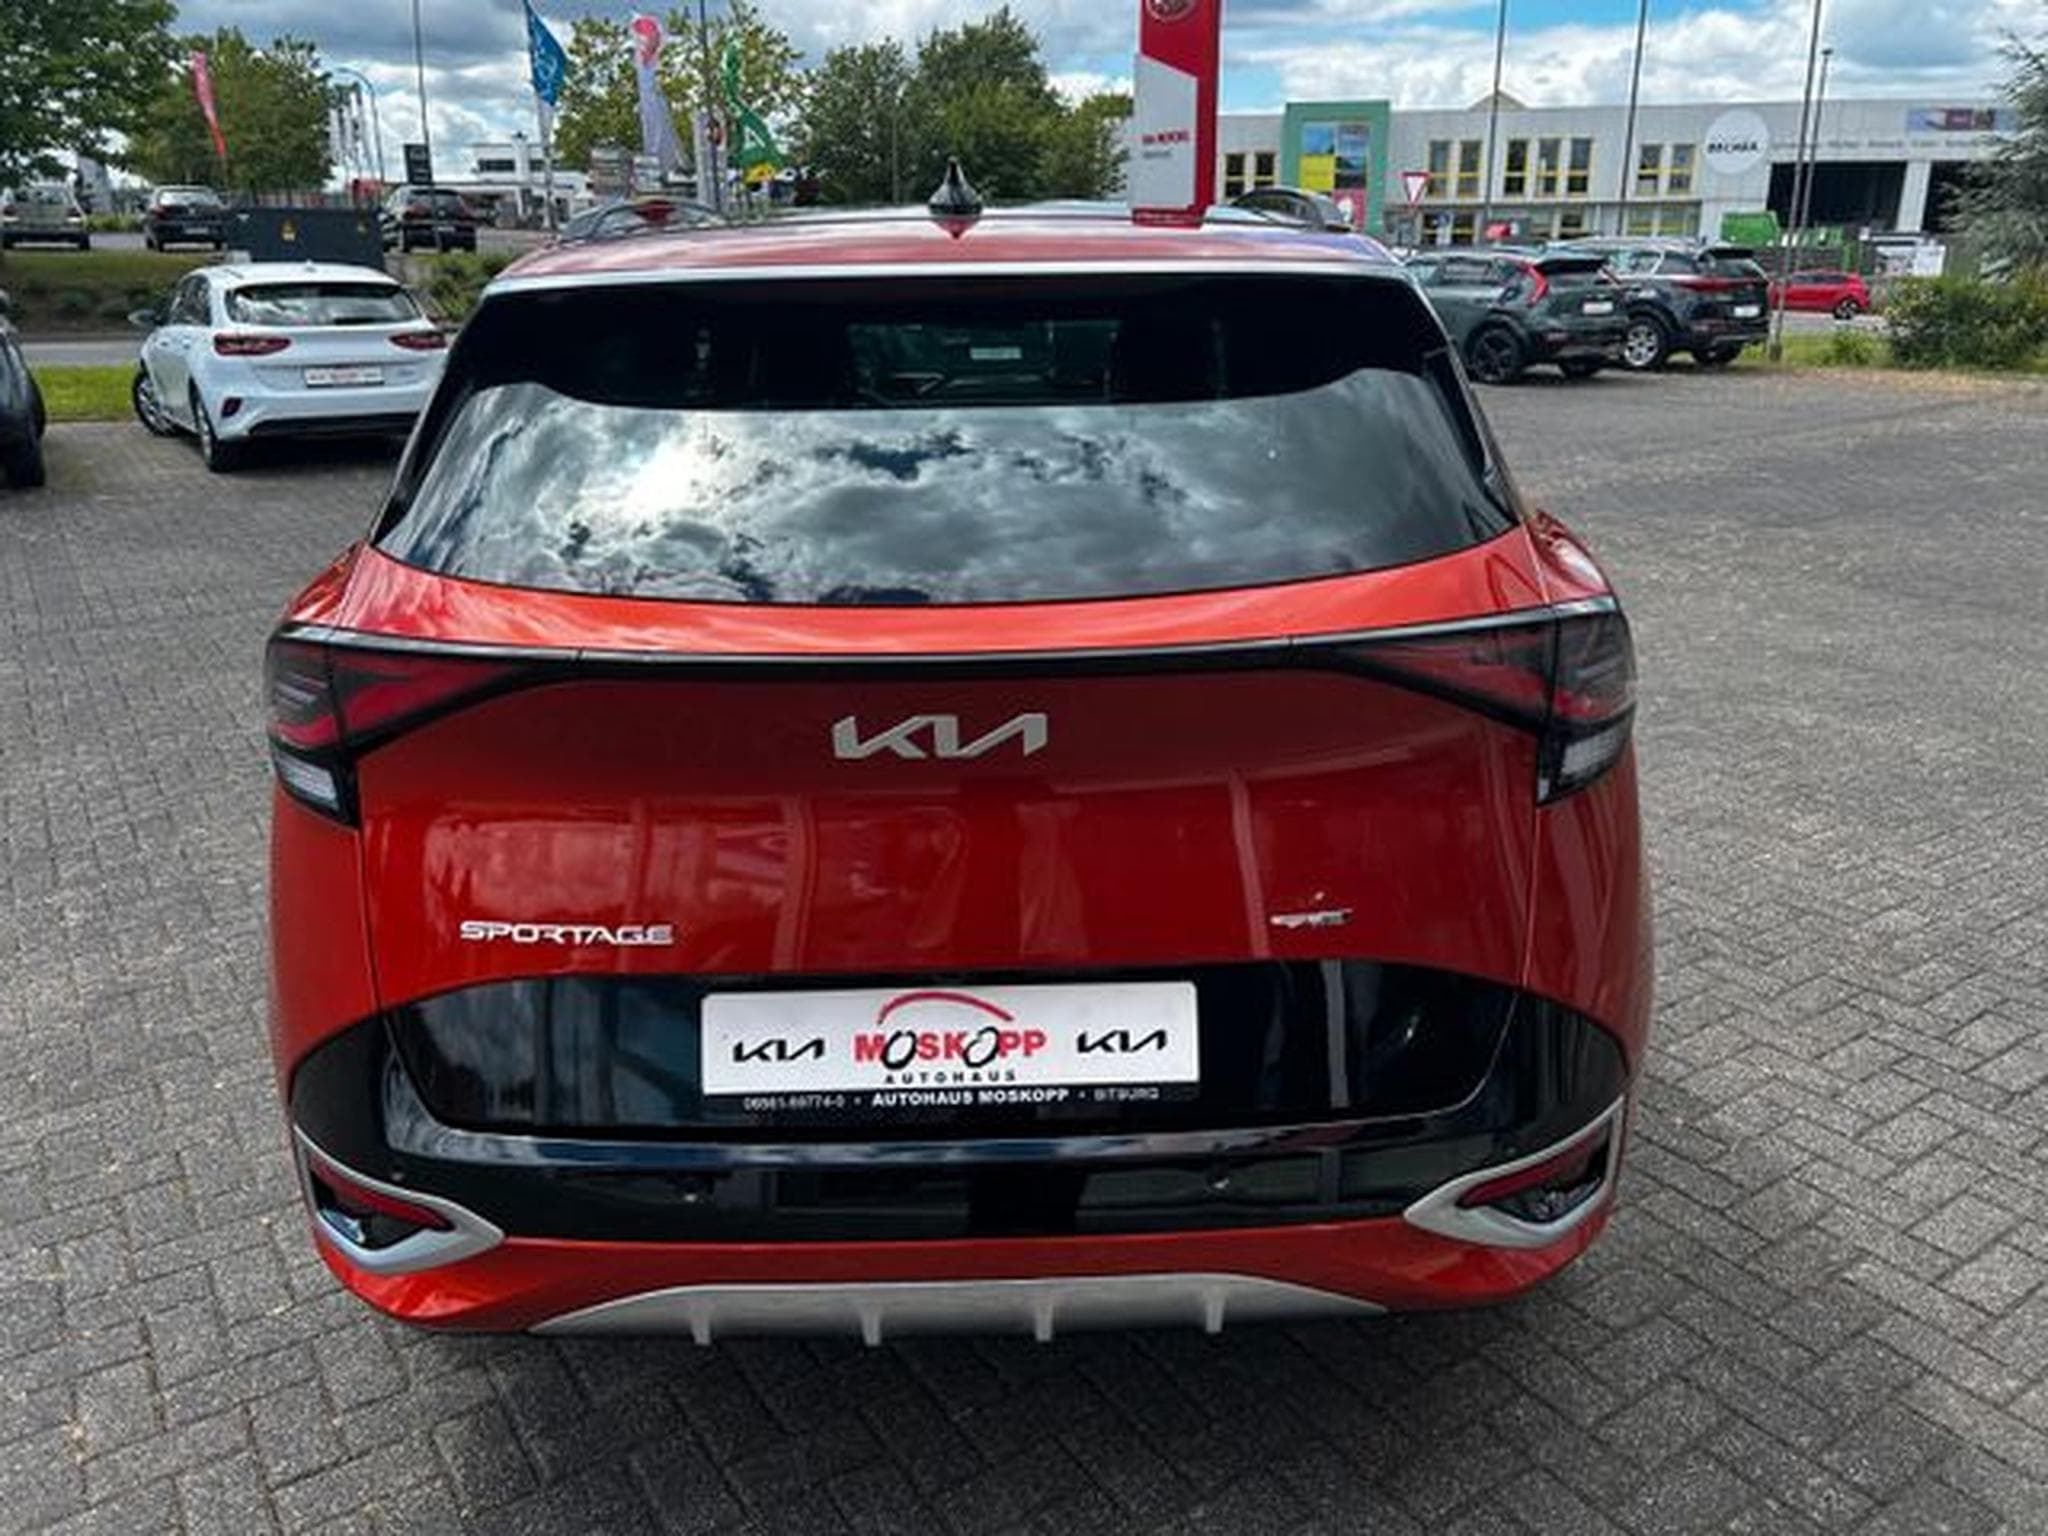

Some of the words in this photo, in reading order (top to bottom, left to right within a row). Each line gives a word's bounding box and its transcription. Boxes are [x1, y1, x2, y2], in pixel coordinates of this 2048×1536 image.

[832, 713, 1048, 759] KIA
[459, 920, 674, 946] SPORTAGE
[733, 1037, 825, 1062] KIA
[854, 1026, 1047, 1070] MOSKOPP
[1077, 1029, 1167, 1054] KIA
[884, 1069, 1017, 1084] AUTOHAUS
[871, 1090, 974, 1107] AUTOHAUS
[977, 1088, 1070, 1105] MOSKOPP
